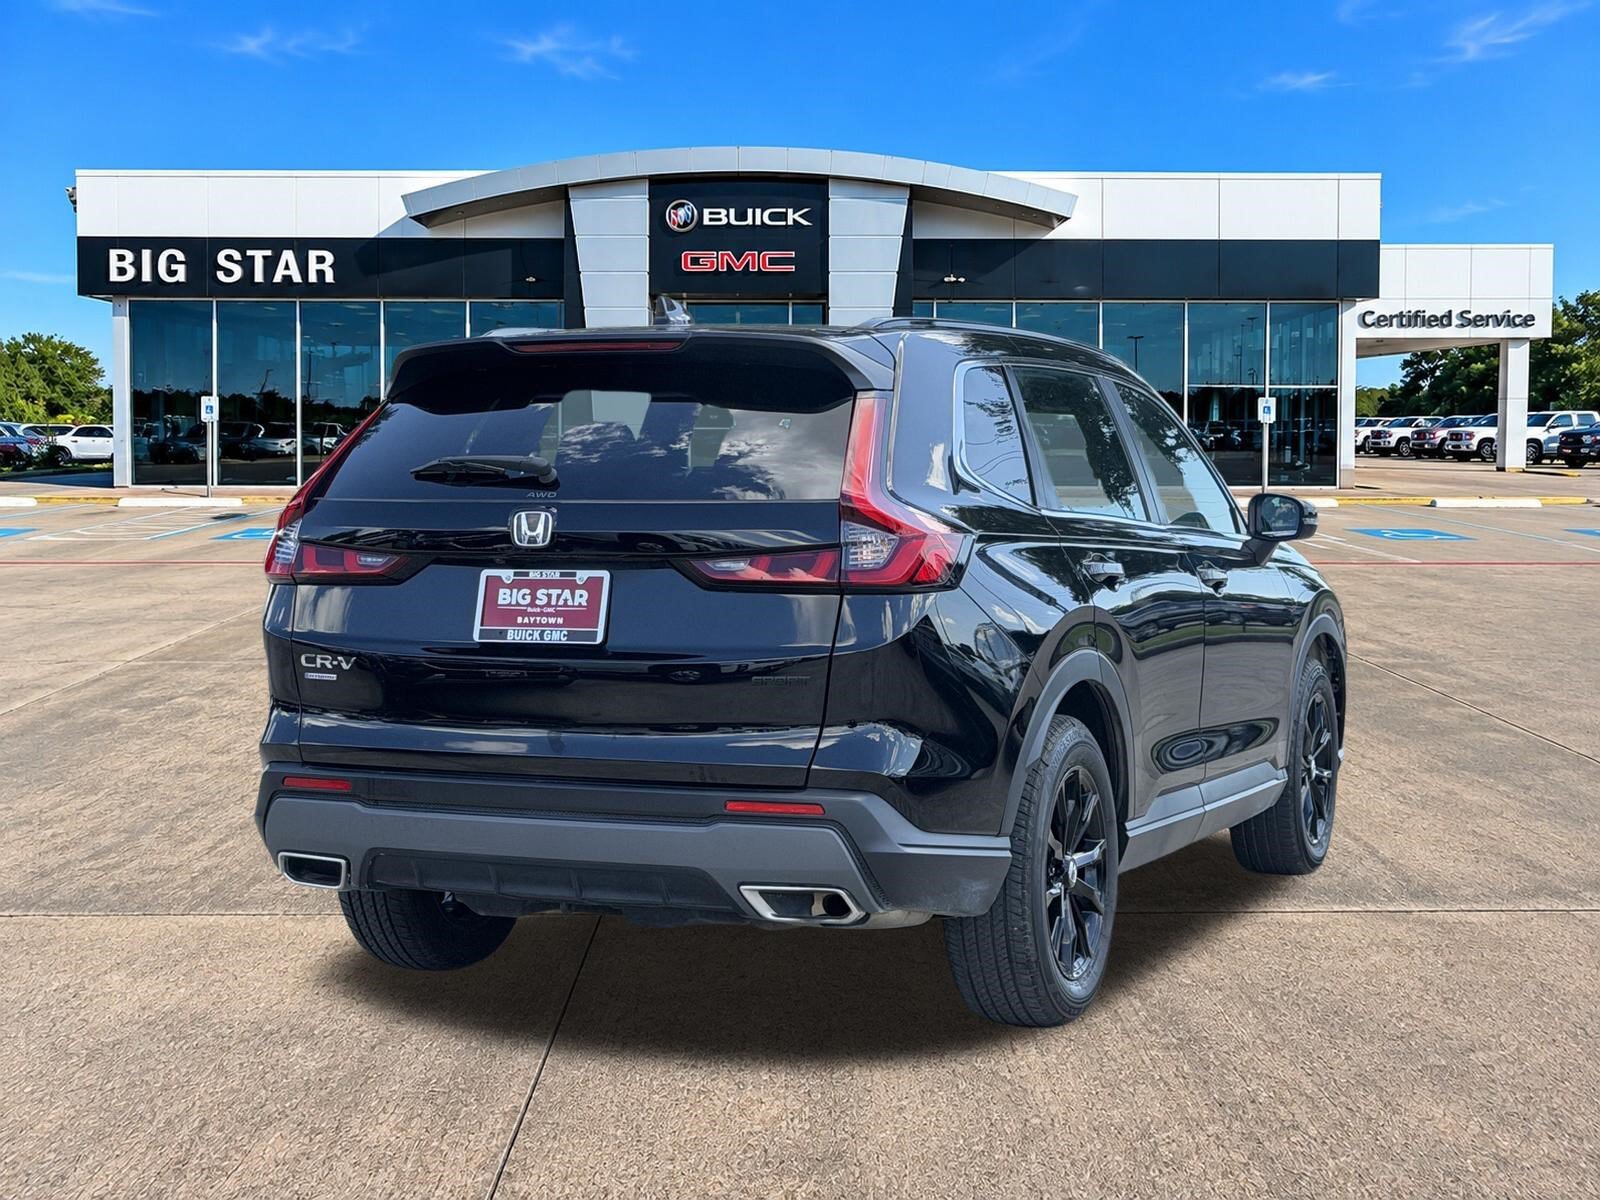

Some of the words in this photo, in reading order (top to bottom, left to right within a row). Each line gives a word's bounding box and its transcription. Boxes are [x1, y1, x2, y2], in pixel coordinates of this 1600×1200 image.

[702, 207, 813, 226] BUICK
[108, 248, 187, 283] BIG
[216, 248, 336, 284] STAR
[681, 250, 796, 272] GMC
[1360, 310, 1453, 328] Certified
[1457, 310, 1536, 328] Service
[497, 588, 531, 605] BIG
[535, 588, 589, 606] STAR
[516, 616, 564, 625] BAYTOWN
[507, 629, 541, 641] BUICK
[543, 630, 568, 642] GMC
[300, 653, 357, 670] CR-V
